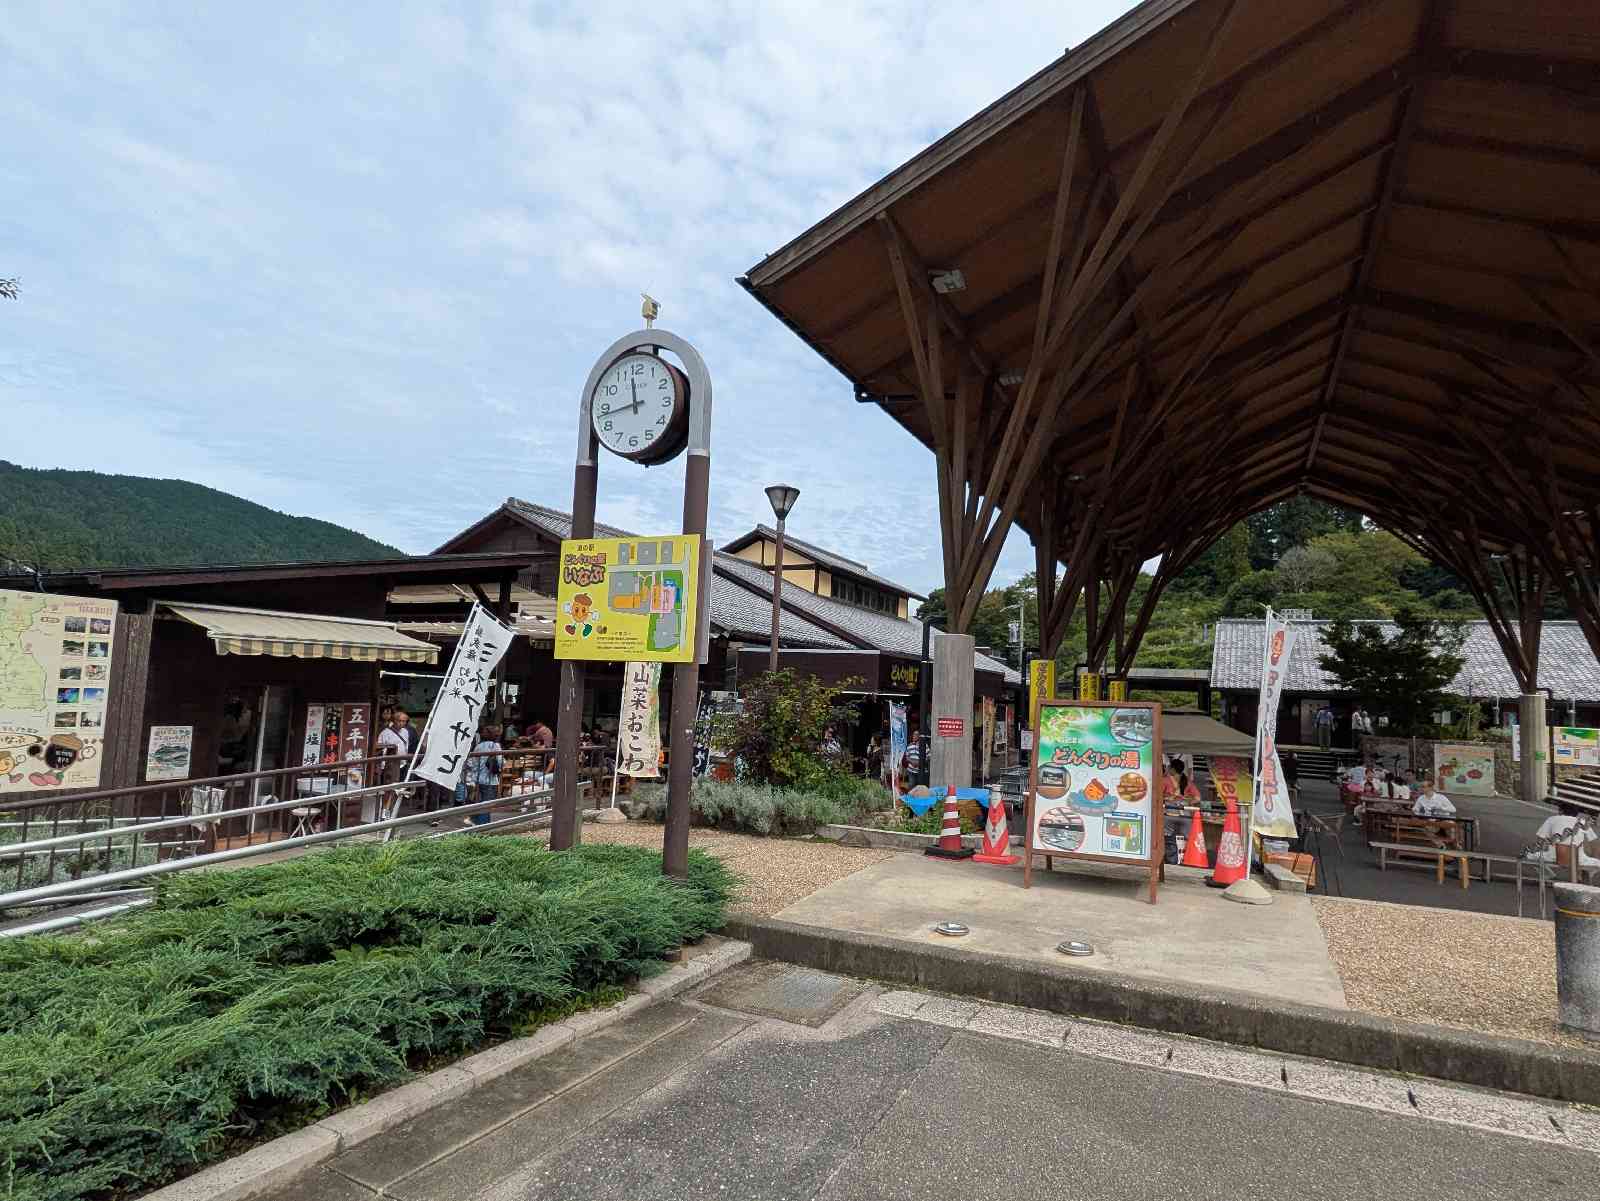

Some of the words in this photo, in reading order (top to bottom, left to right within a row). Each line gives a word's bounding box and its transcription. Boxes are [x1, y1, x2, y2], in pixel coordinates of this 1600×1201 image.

[631, 364, 644, 375] 12
[651, 367, 655, 377] 1
[617, 371, 627, 382] 11
[659, 378, 668, 390] 2
[605, 385, 618, 396] 10
[662, 397, 671, 407] 3
[601, 403, 610, 414] 9
[656, 415, 665, 425] 4
[604, 421, 613, 431] 8
[615, 432, 624, 443] 7
[645, 430, 654, 440] 5
[629, 436, 638, 446] 6
[563, 565, 606, 587] いなぶ
[624, 663, 650, 772] 山菜おこわ
[1053, 746, 1140, 770] どんぐりの湯
